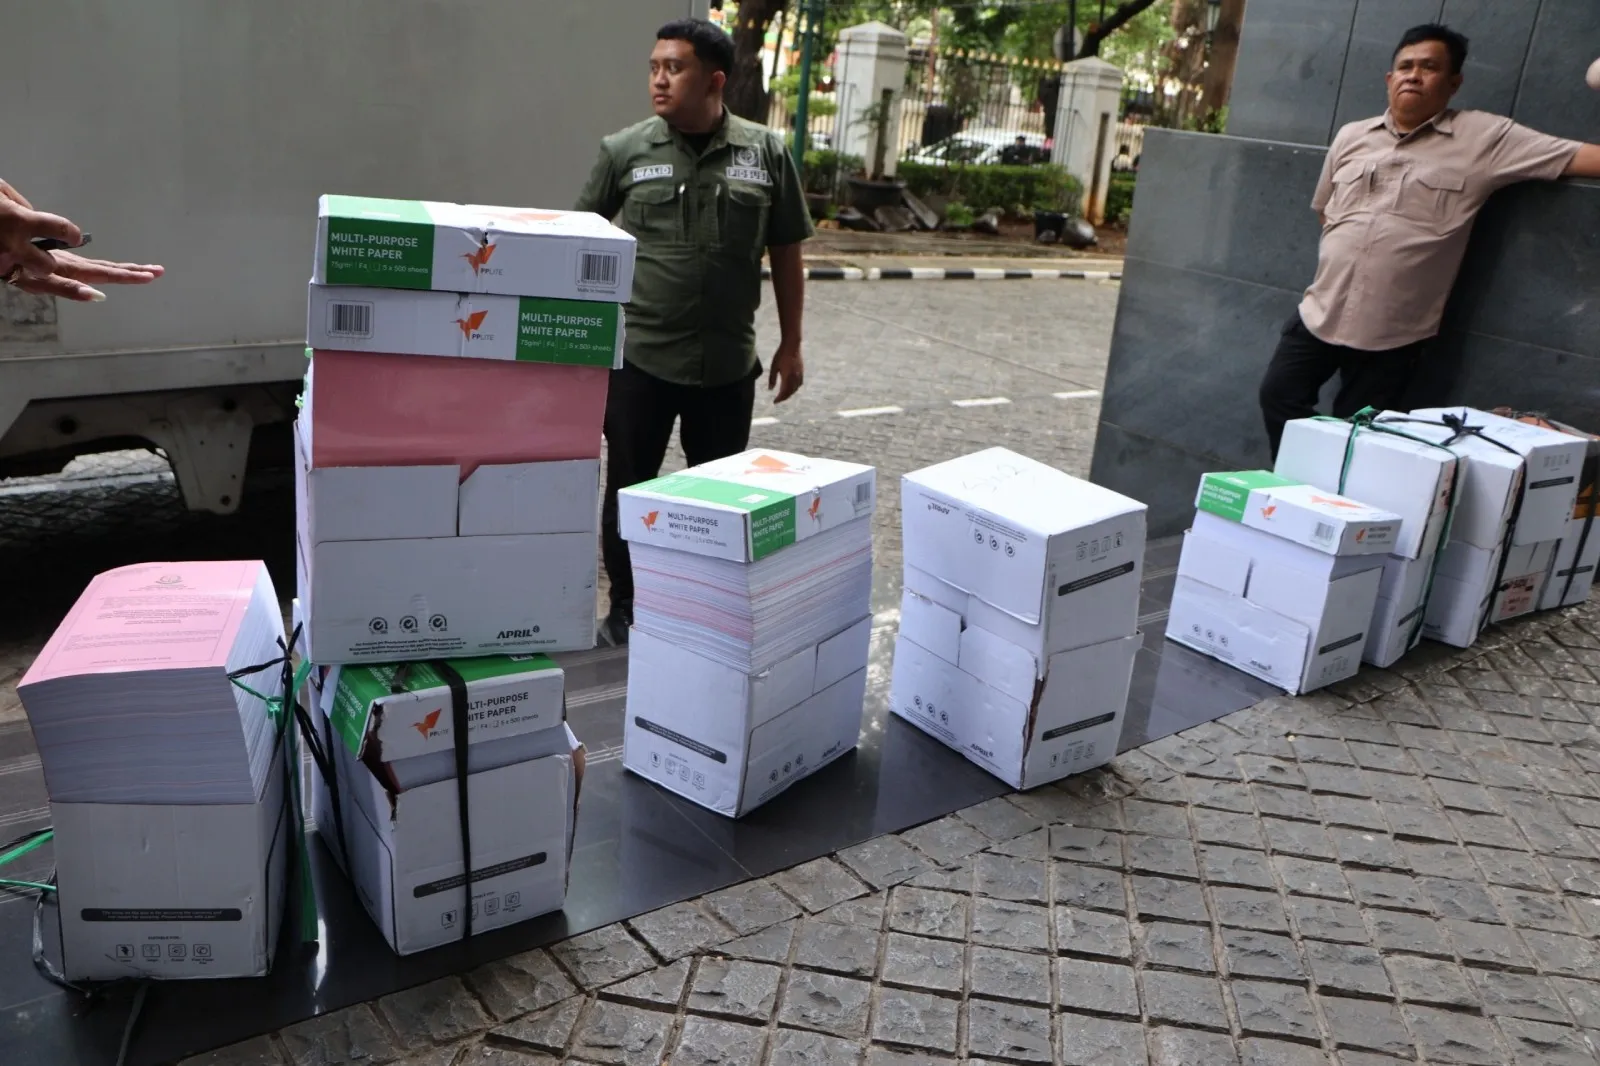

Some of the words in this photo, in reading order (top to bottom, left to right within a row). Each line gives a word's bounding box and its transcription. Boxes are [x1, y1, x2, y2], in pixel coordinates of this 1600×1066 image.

[331, 232, 418, 247] MULTI-PURPOSE
[331, 246, 365, 257] WHITE
[367, 248, 402, 259] PAPER
[521, 312, 603, 327] MULTI-PURPOSE
[521, 325, 553, 336] WHITE
[555, 327, 588, 338] PAPER
[667, 511, 719, 527] MULTI-PURPOSE
[668, 522, 688, 531] WHITE
[689, 524, 710, 534] PAPER
[497, 627, 533, 640] APRIL
[487, 705, 516, 718] PAPER
